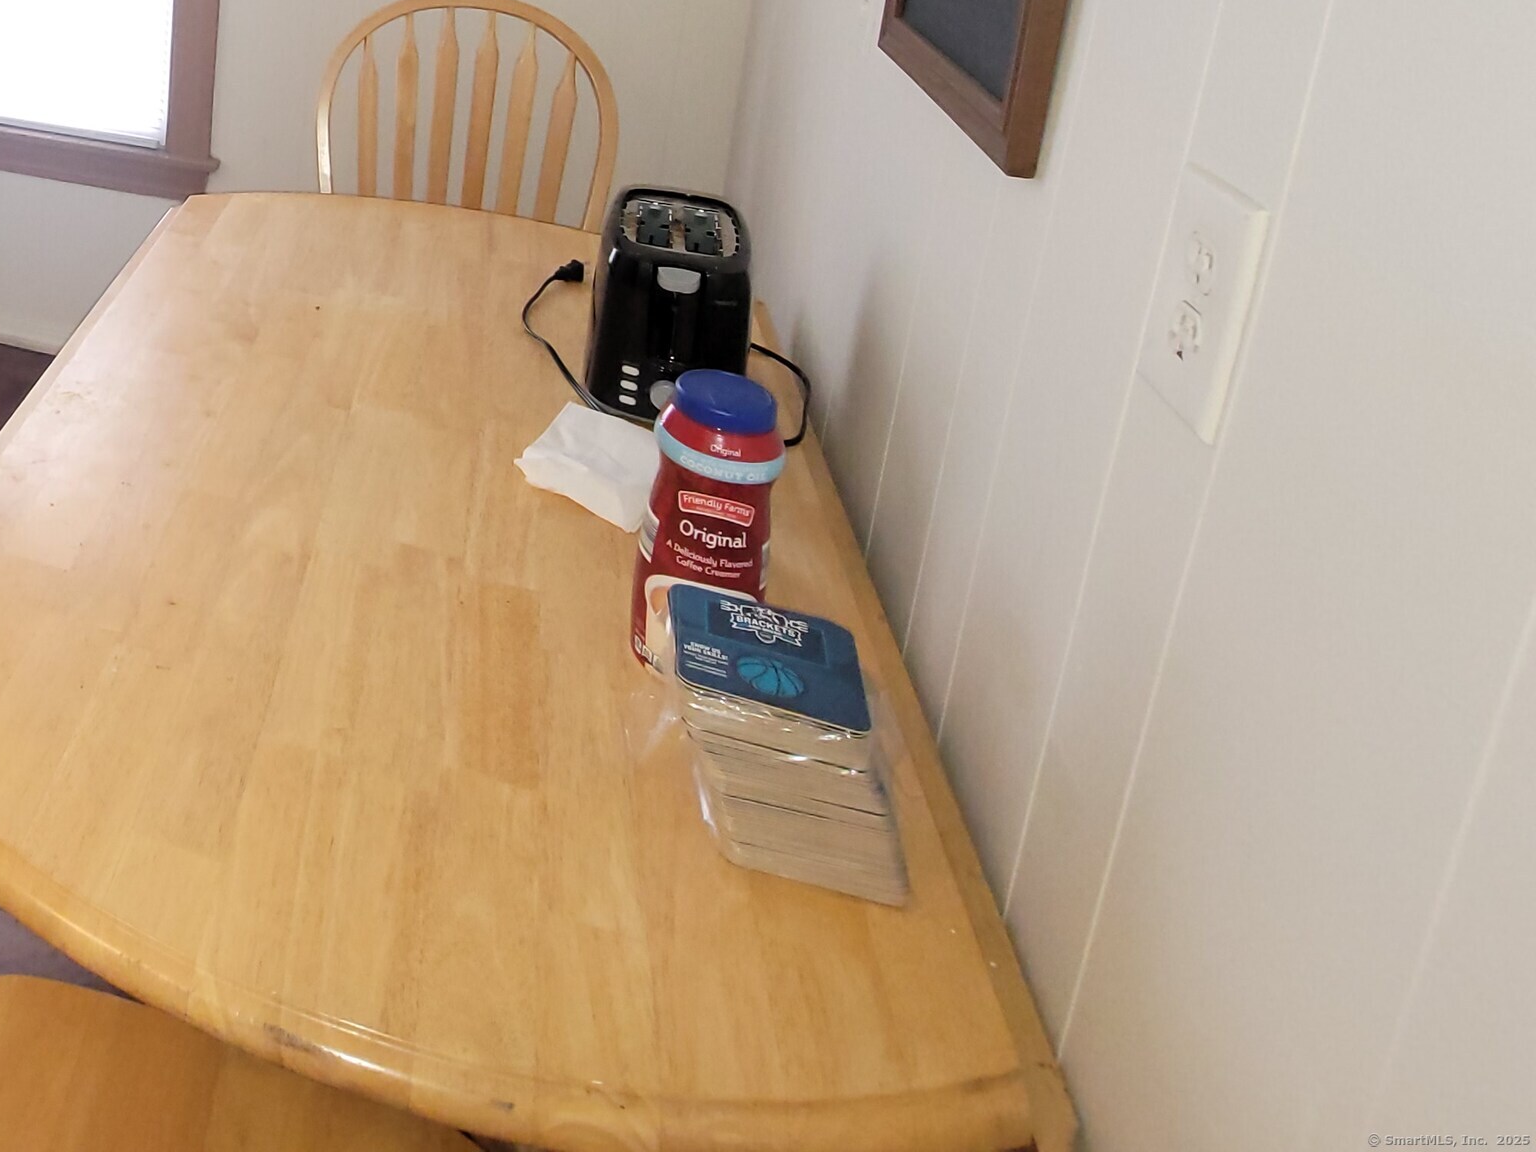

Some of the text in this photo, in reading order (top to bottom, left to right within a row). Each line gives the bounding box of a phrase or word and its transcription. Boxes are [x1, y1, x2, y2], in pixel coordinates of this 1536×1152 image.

[710, 444, 741, 457] Original
[679, 455, 744, 481] COCONUT
[746, 472, 768, 482] OIL
[683, 494, 722, 511] Friendly
[724, 503, 750, 517] Farms
[679, 519, 747, 549] Original
[666, 539, 754, 568] A Deliciously Flavored
[676, 555, 741, 579] Coffee Creamer
[736, 614, 797, 638] BRACKETS
